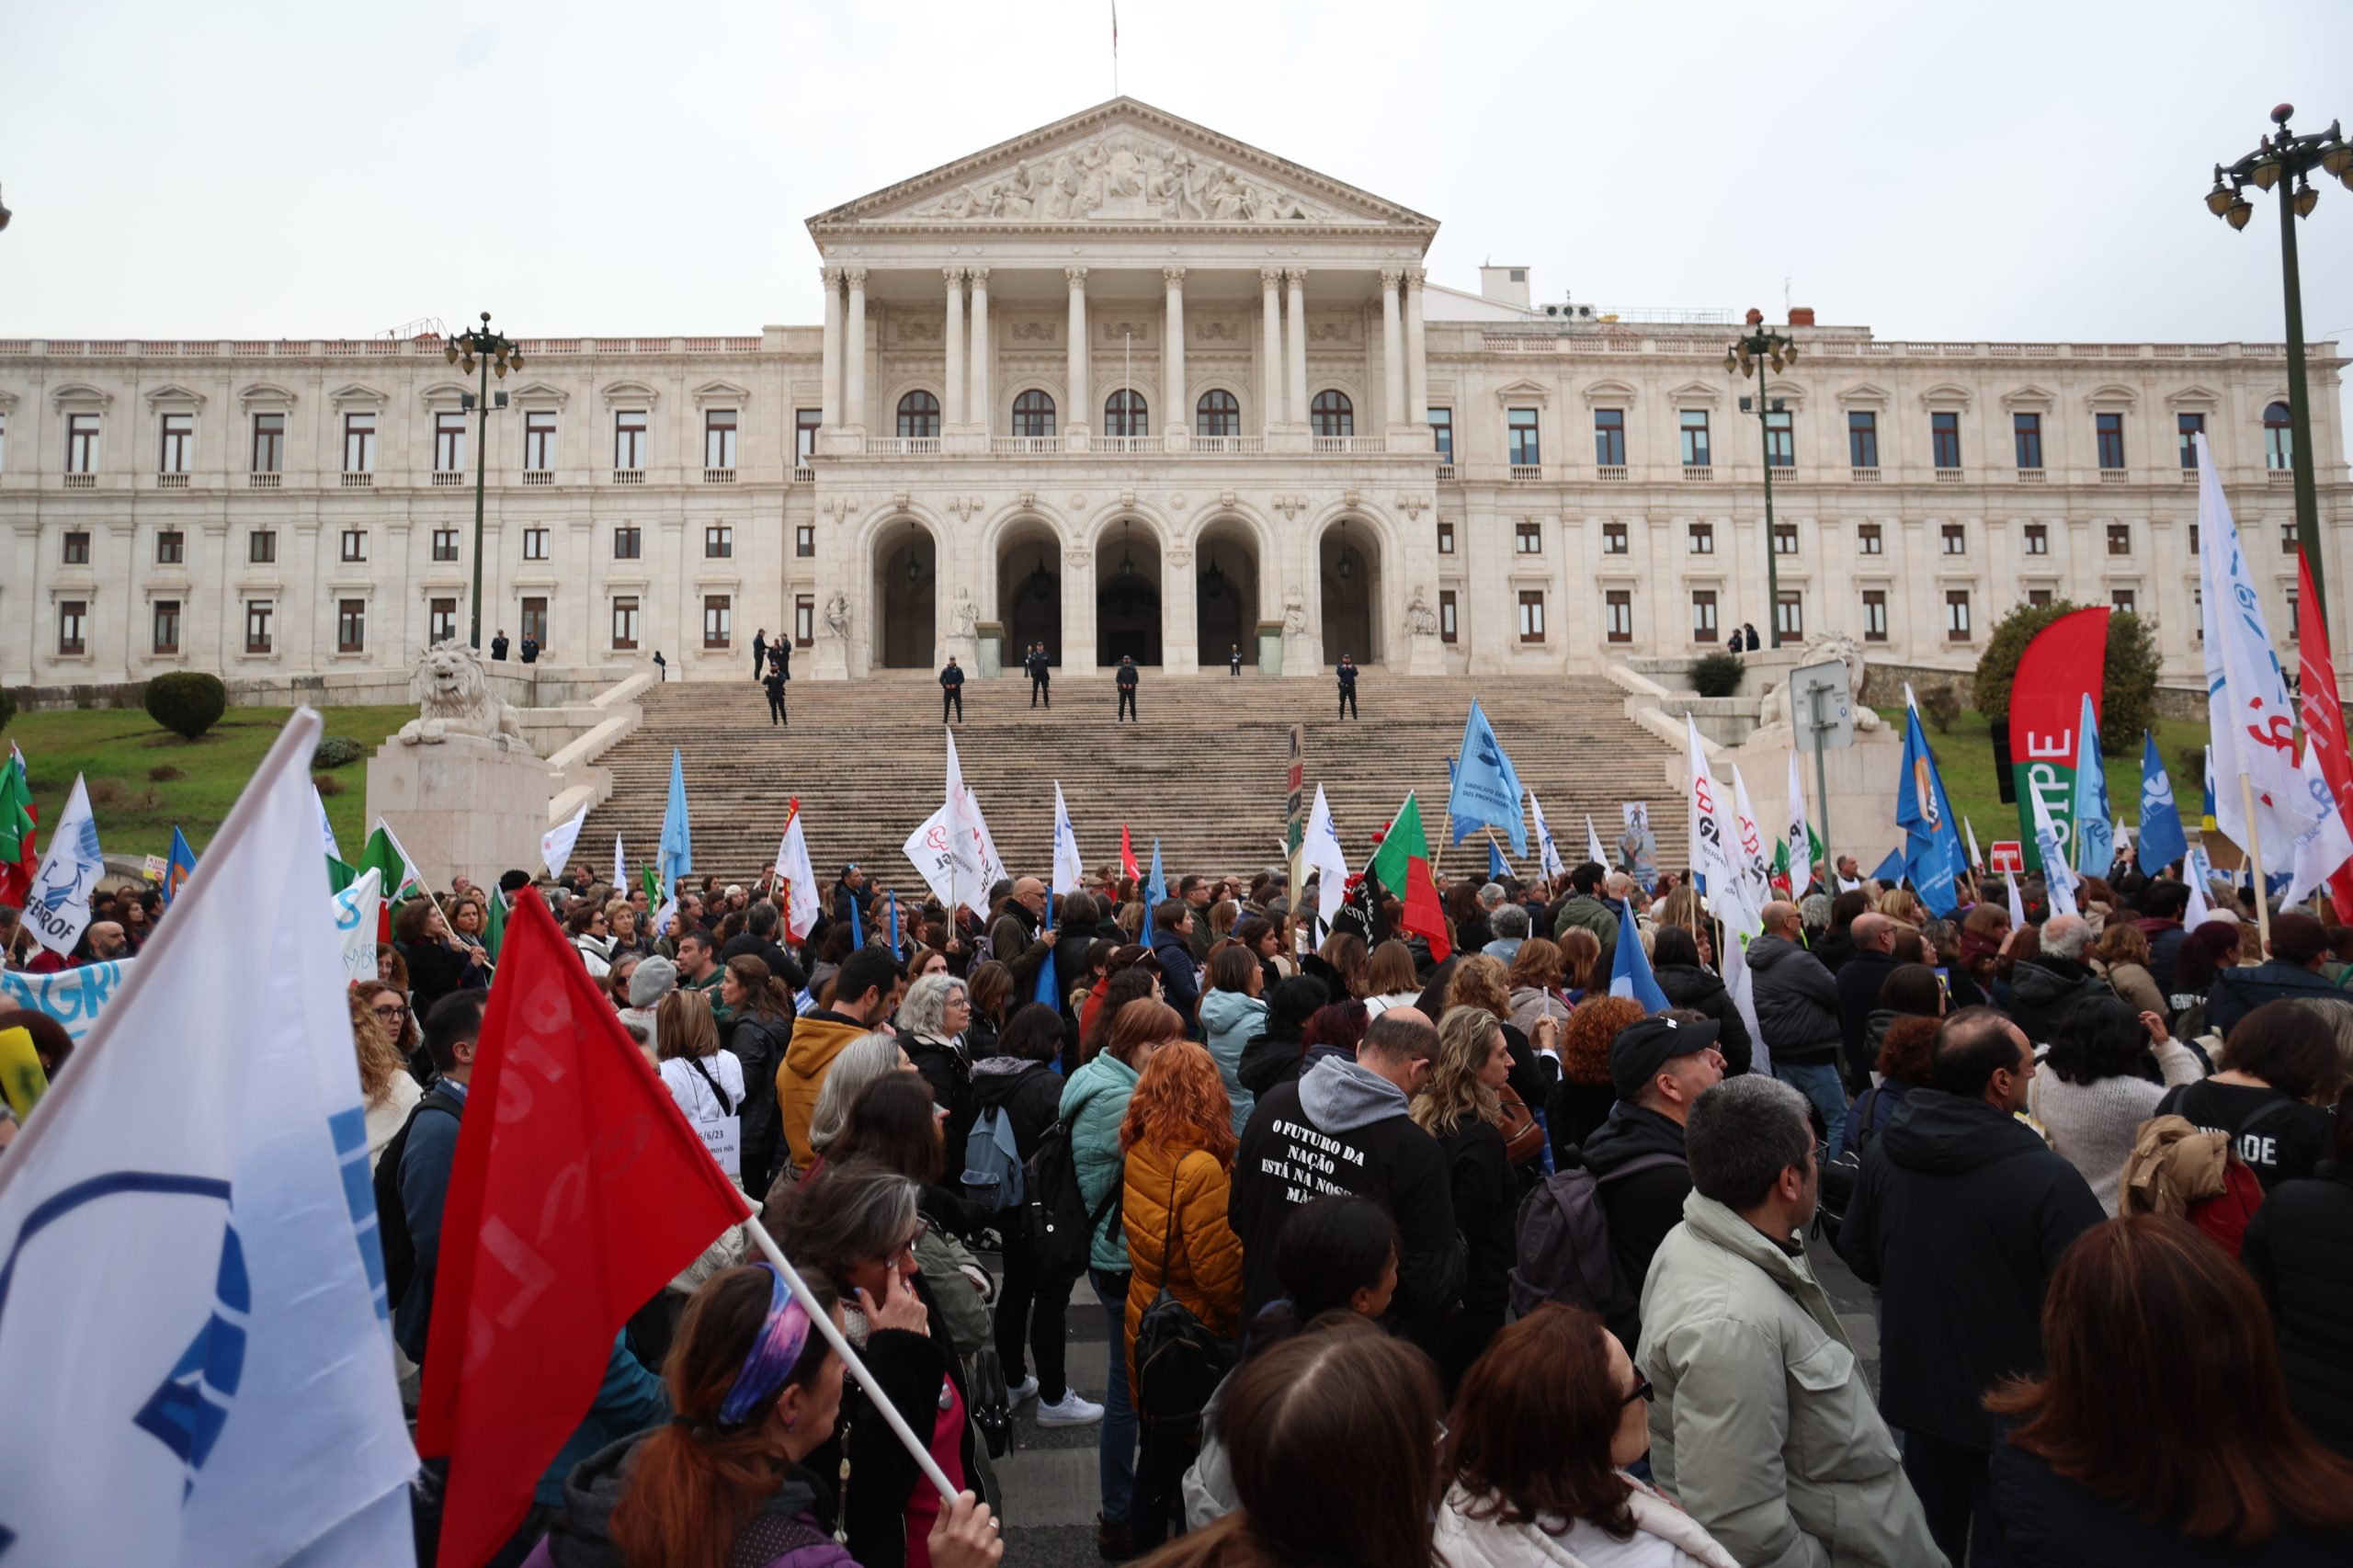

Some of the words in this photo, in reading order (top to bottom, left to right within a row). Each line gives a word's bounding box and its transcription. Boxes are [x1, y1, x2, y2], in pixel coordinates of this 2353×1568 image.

[1474, 792, 1509, 810] PROFESSORE
[1272, 1119, 1282, 1133] O
[1282, 1121, 1341, 1155] FUTURO
[1342, 1145, 1365, 1167] DA
[1261, 1158, 1290, 1179] ESTÁ
[1292, 1167, 1312, 1187] NA
[1287, 1144, 1335, 1175] NAÇÃO
